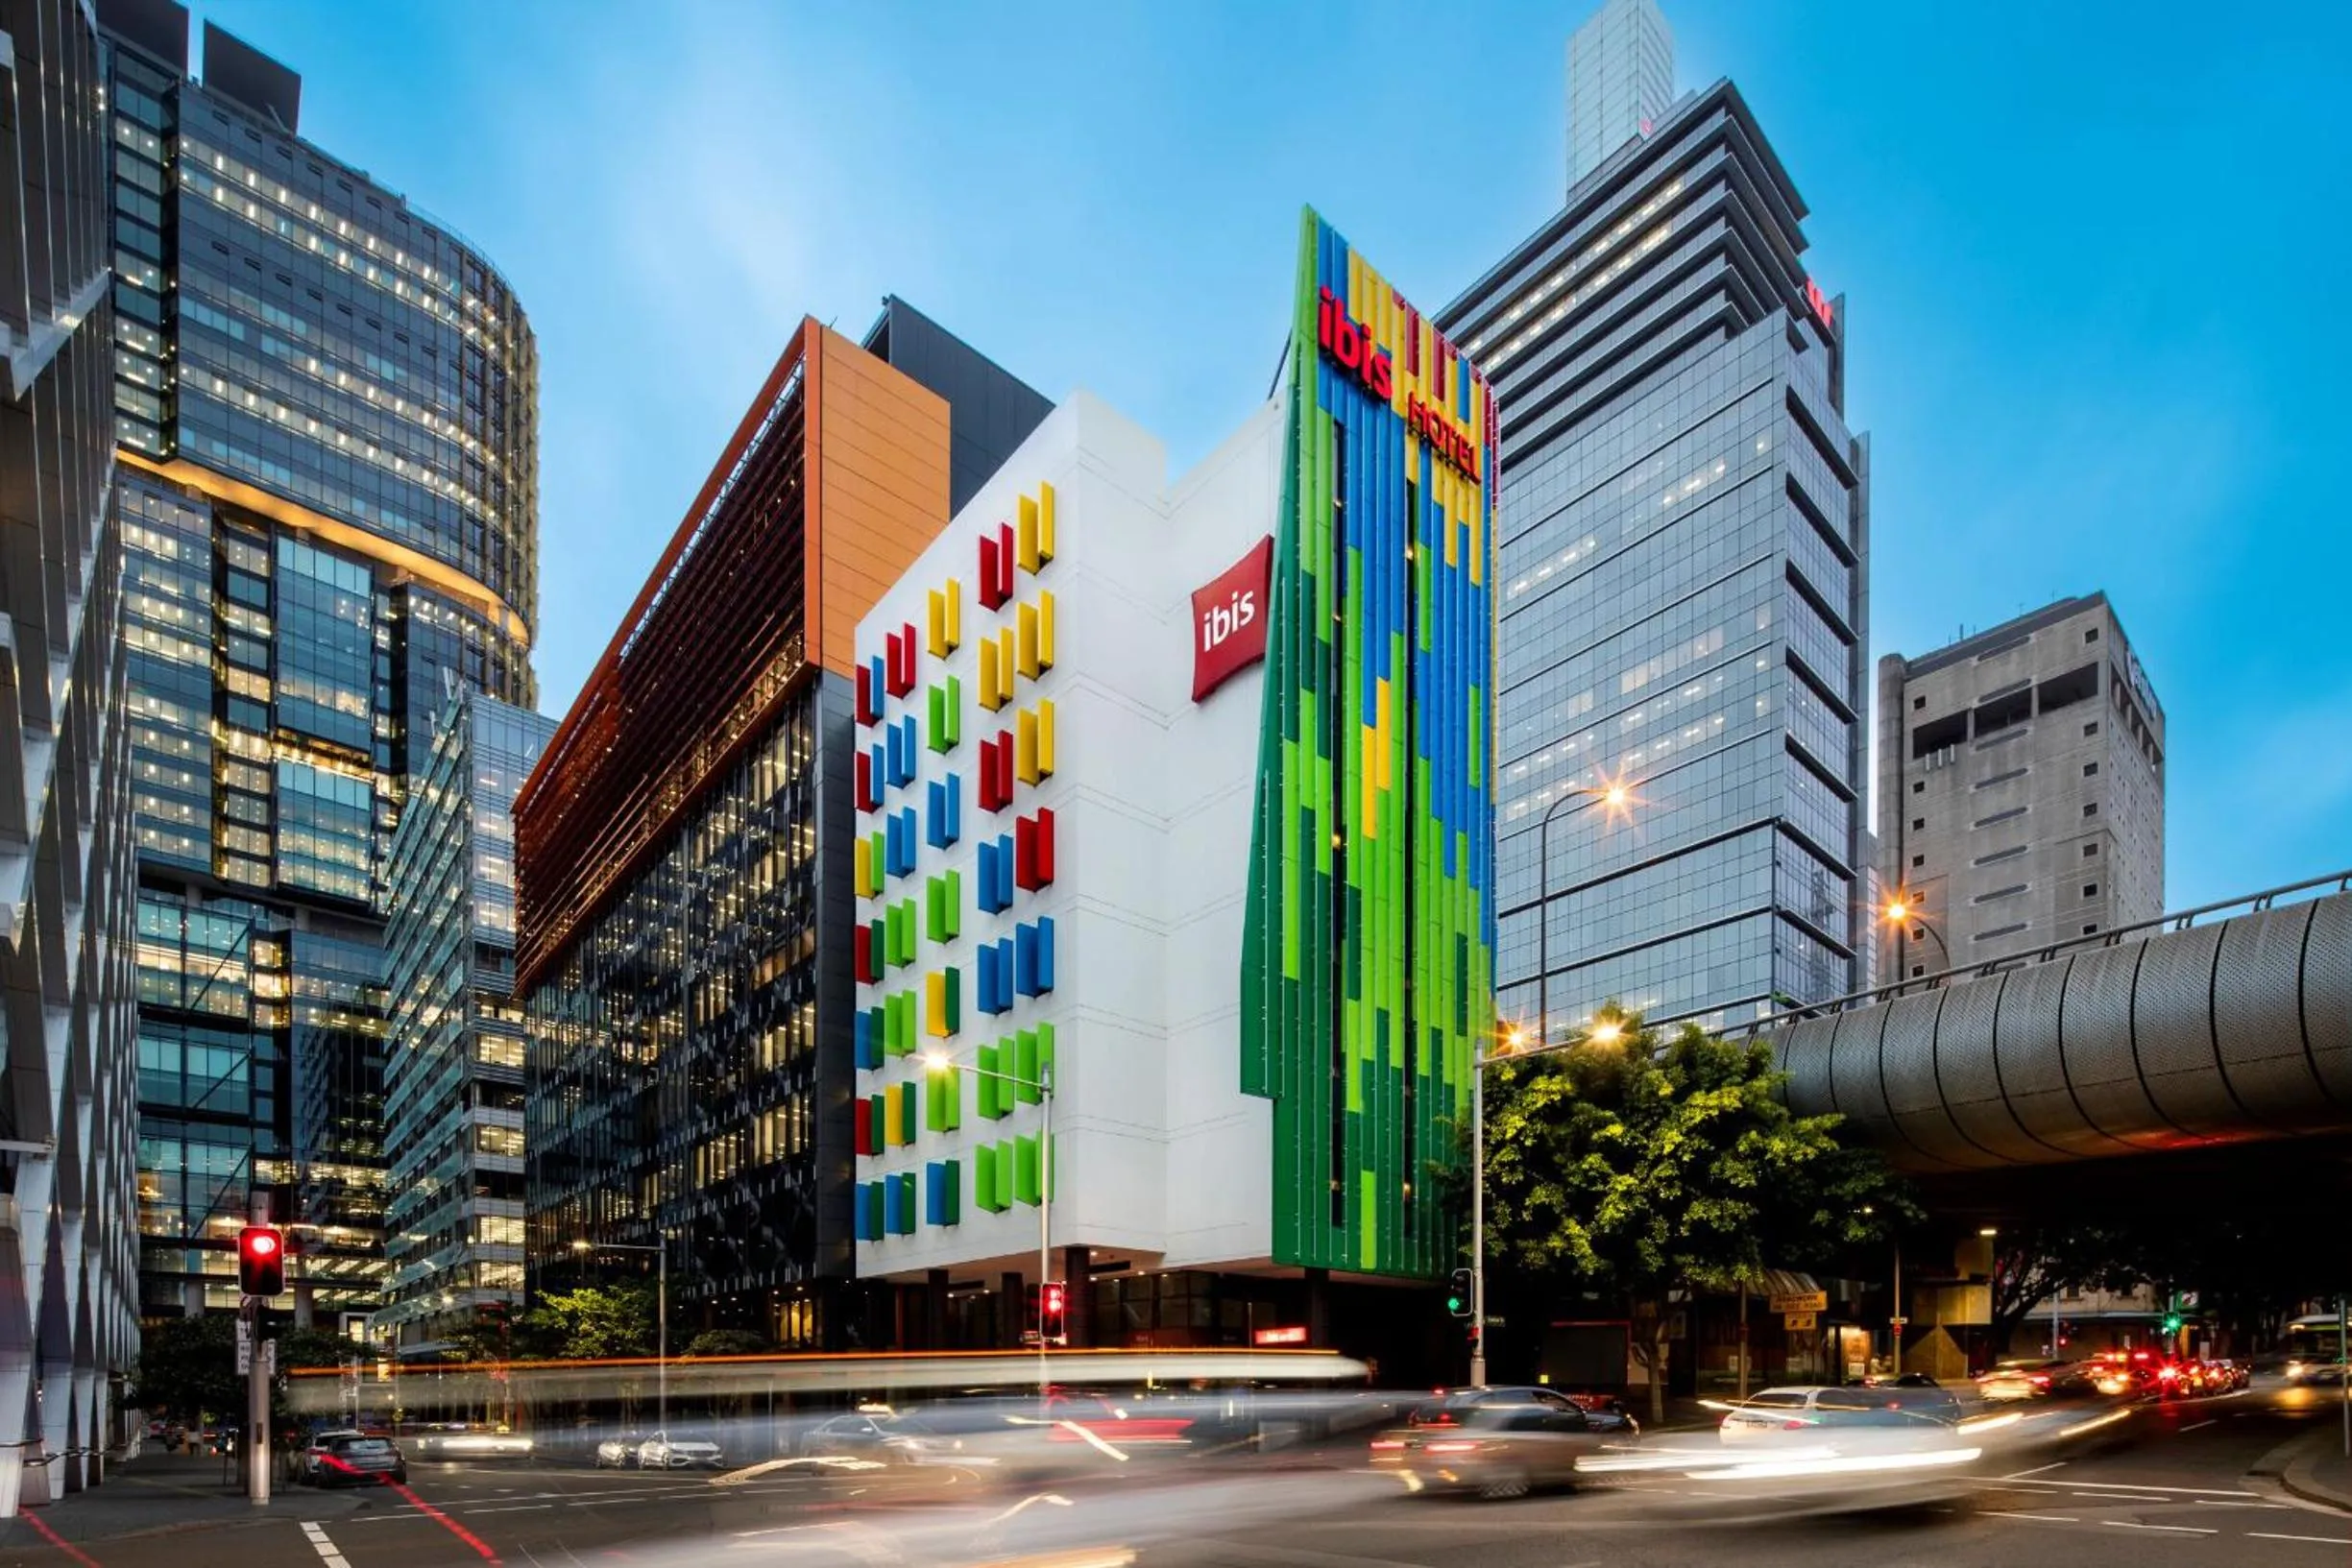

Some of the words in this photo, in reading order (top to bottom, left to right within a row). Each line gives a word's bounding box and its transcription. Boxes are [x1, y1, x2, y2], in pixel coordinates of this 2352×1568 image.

[1318, 285, 1394, 400] ibis
[1408, 391, 1481, 485] HOTEL
[1203, 590, 1255, 653] ibis
